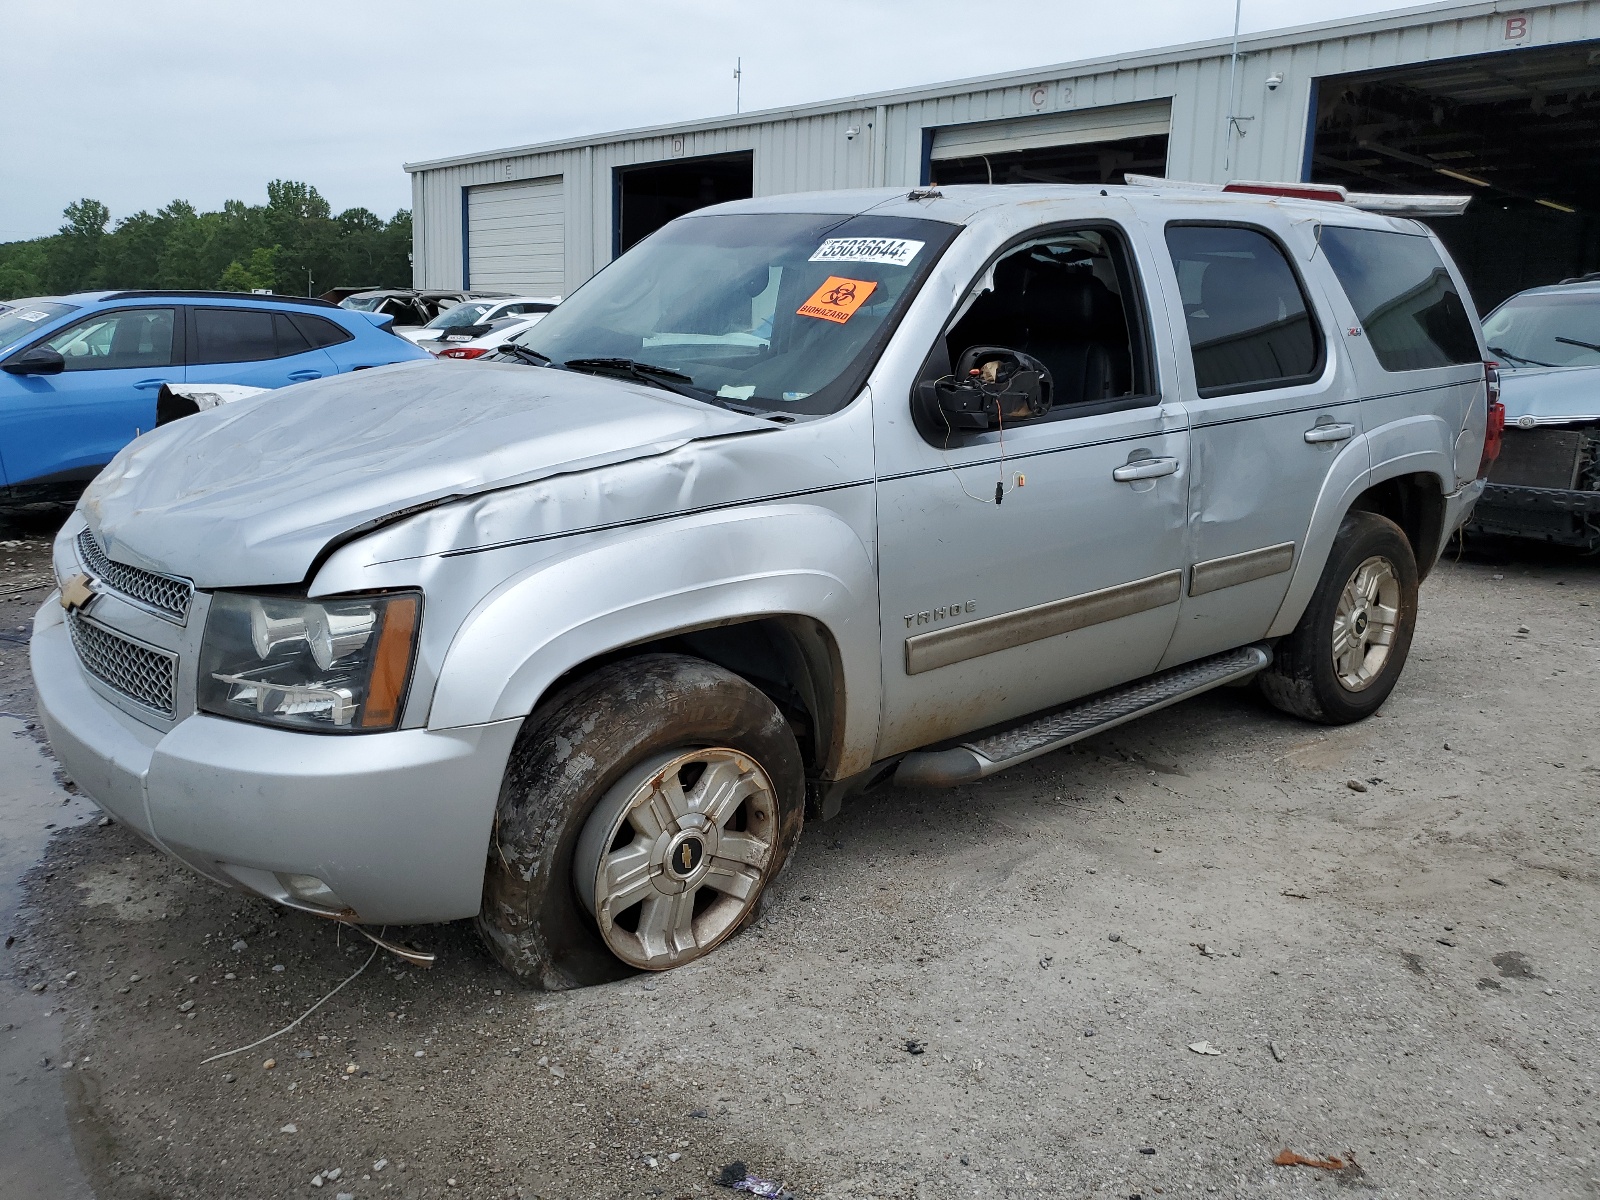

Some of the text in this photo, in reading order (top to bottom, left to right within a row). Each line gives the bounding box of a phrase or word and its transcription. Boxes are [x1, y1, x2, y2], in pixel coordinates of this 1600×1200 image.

[1505, 17, 1527, 40] B
[1032, 89, 1045, 107] C
[674, 140, 682, 153] D
[505, 164, 512, 176] E
[799, 304, 850, 321] BIOHAZARD
[903, 598, 977, 629] TAHOE
